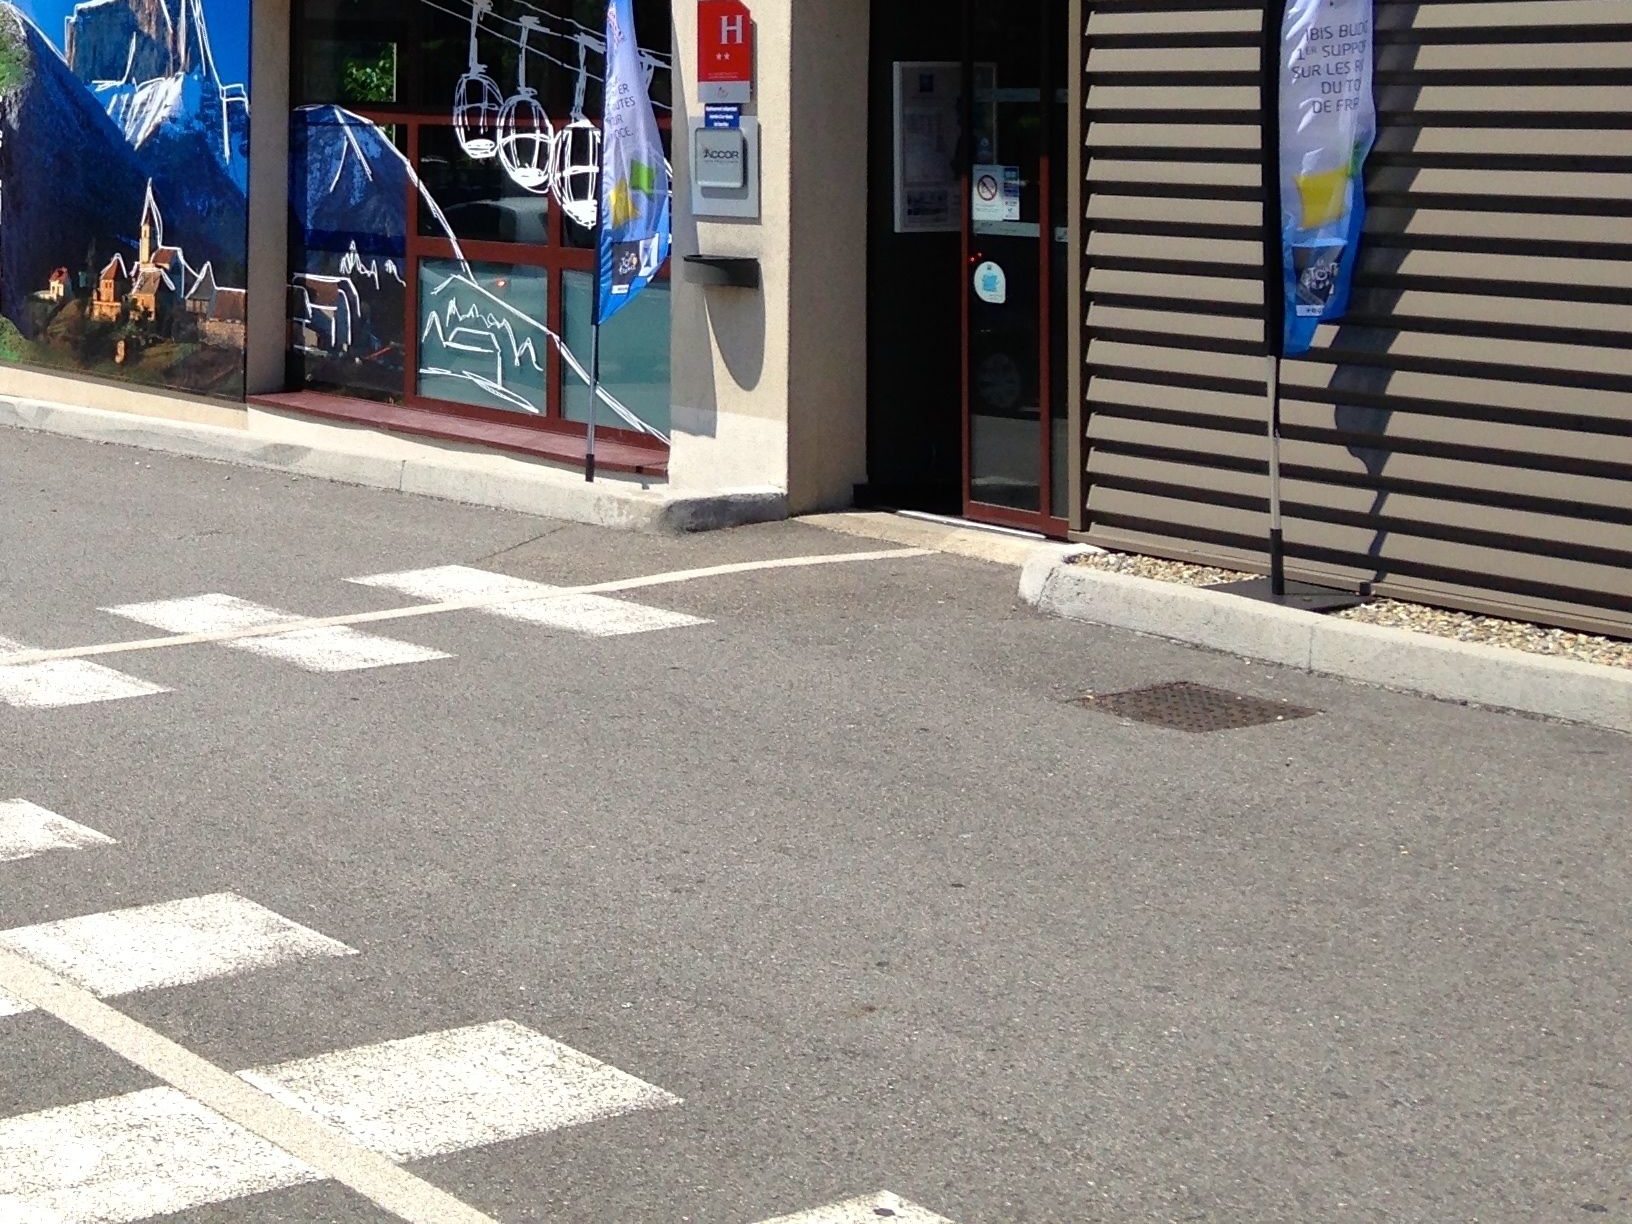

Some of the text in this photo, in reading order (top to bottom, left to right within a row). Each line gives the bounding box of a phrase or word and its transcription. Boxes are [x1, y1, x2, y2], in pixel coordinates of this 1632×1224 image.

[720, 14, 743, 44] H
[1291, 64, 1321, 78] SUR
[1326, 61, 1350, 75] LES
[1321, 81, 1342, 94] DU
[1312, 100, 1331, 113] DE
